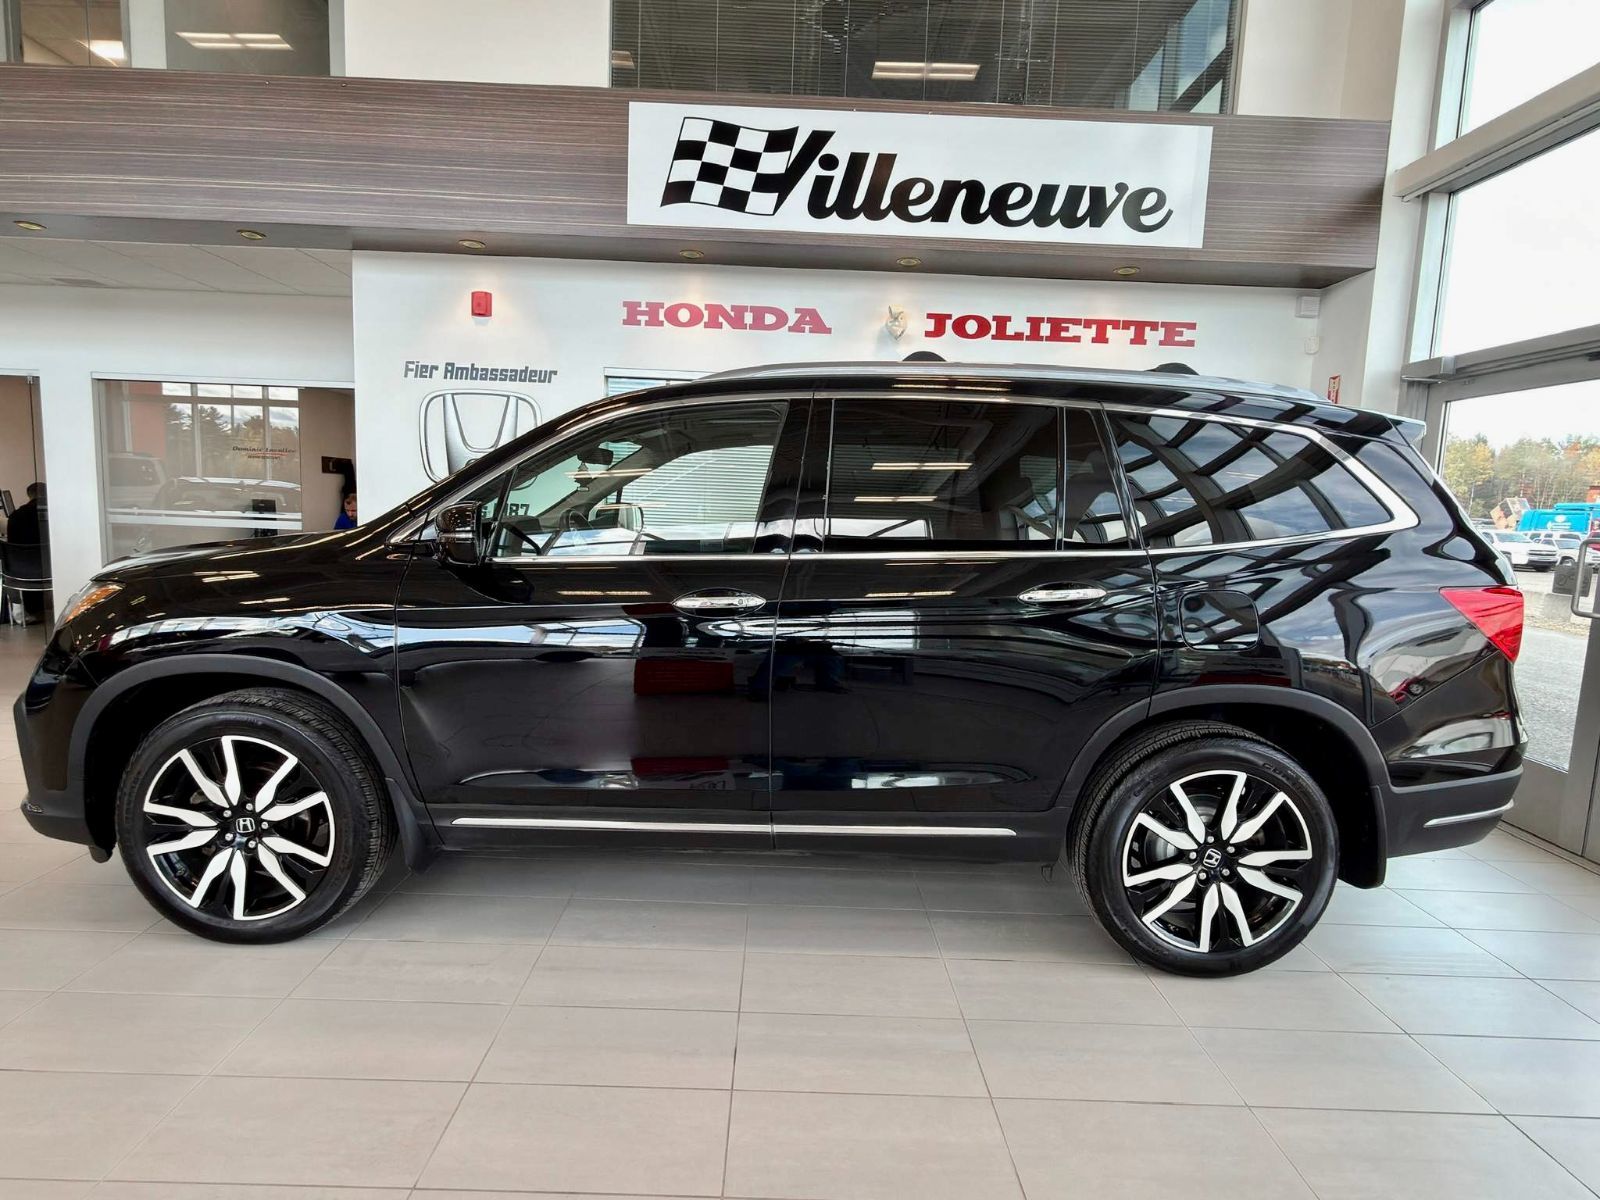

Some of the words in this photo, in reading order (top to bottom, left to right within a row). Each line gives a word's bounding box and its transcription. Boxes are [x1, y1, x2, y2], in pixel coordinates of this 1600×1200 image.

[773, 129, 1173, 233] Villeneuve
[622, 301, 832, 334] HONDA
[924, 313, 1197, 347] JOLIETTE
[404, 361, 439, 379] Fier
[443, 362, 558, 384] Ambassadeur
